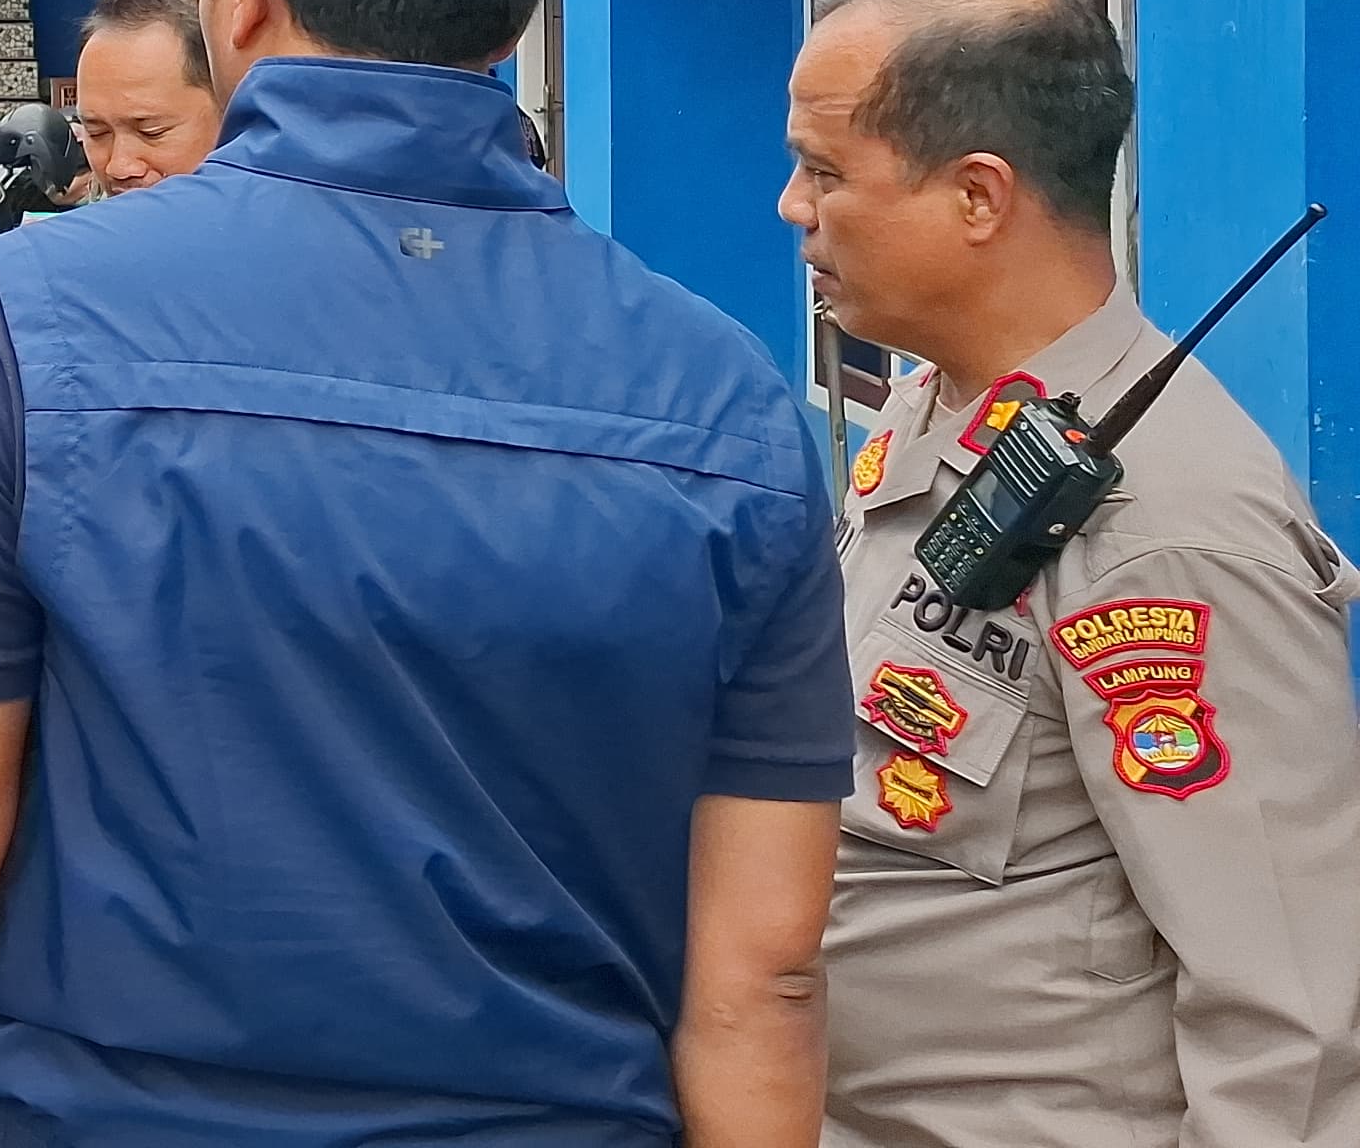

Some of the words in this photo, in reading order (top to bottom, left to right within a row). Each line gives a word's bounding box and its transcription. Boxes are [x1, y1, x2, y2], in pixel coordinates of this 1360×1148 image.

[890, 572, 1029, 681] POLRI
[1059, 606, 1196, 648] POLRESTA
[1098, 666, 1192, 690] LAMPUNG
